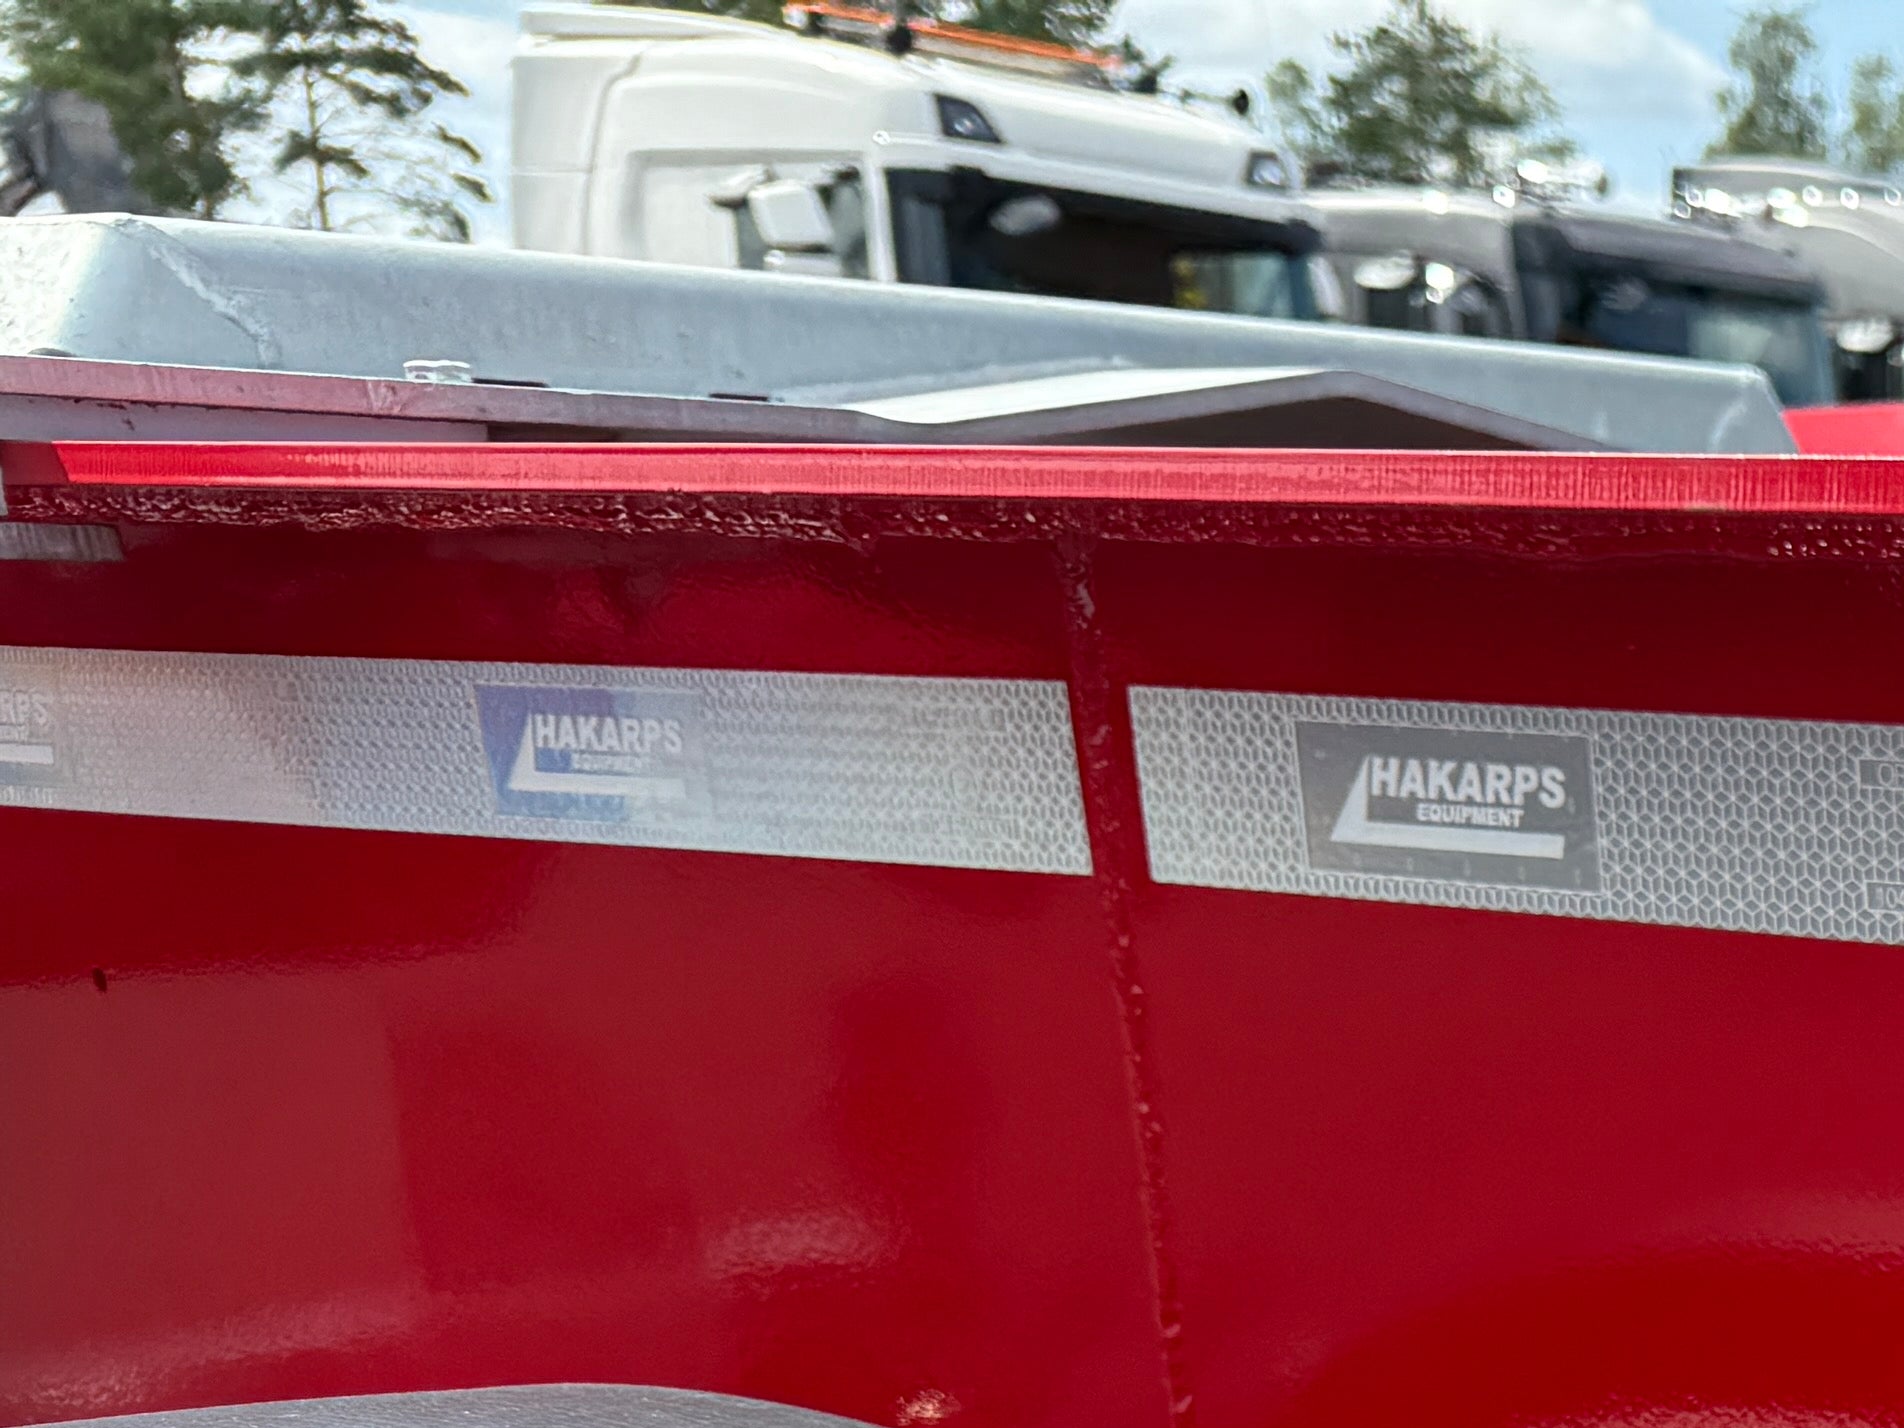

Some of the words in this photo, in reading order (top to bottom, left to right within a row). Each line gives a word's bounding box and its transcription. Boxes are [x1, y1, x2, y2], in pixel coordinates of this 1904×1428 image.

[535, 712, 683, 753] HAKARPS
[1371, 756, 1566, 809] HAKARPS
[1416, 803, 1525, 828] EQUIPMENT
